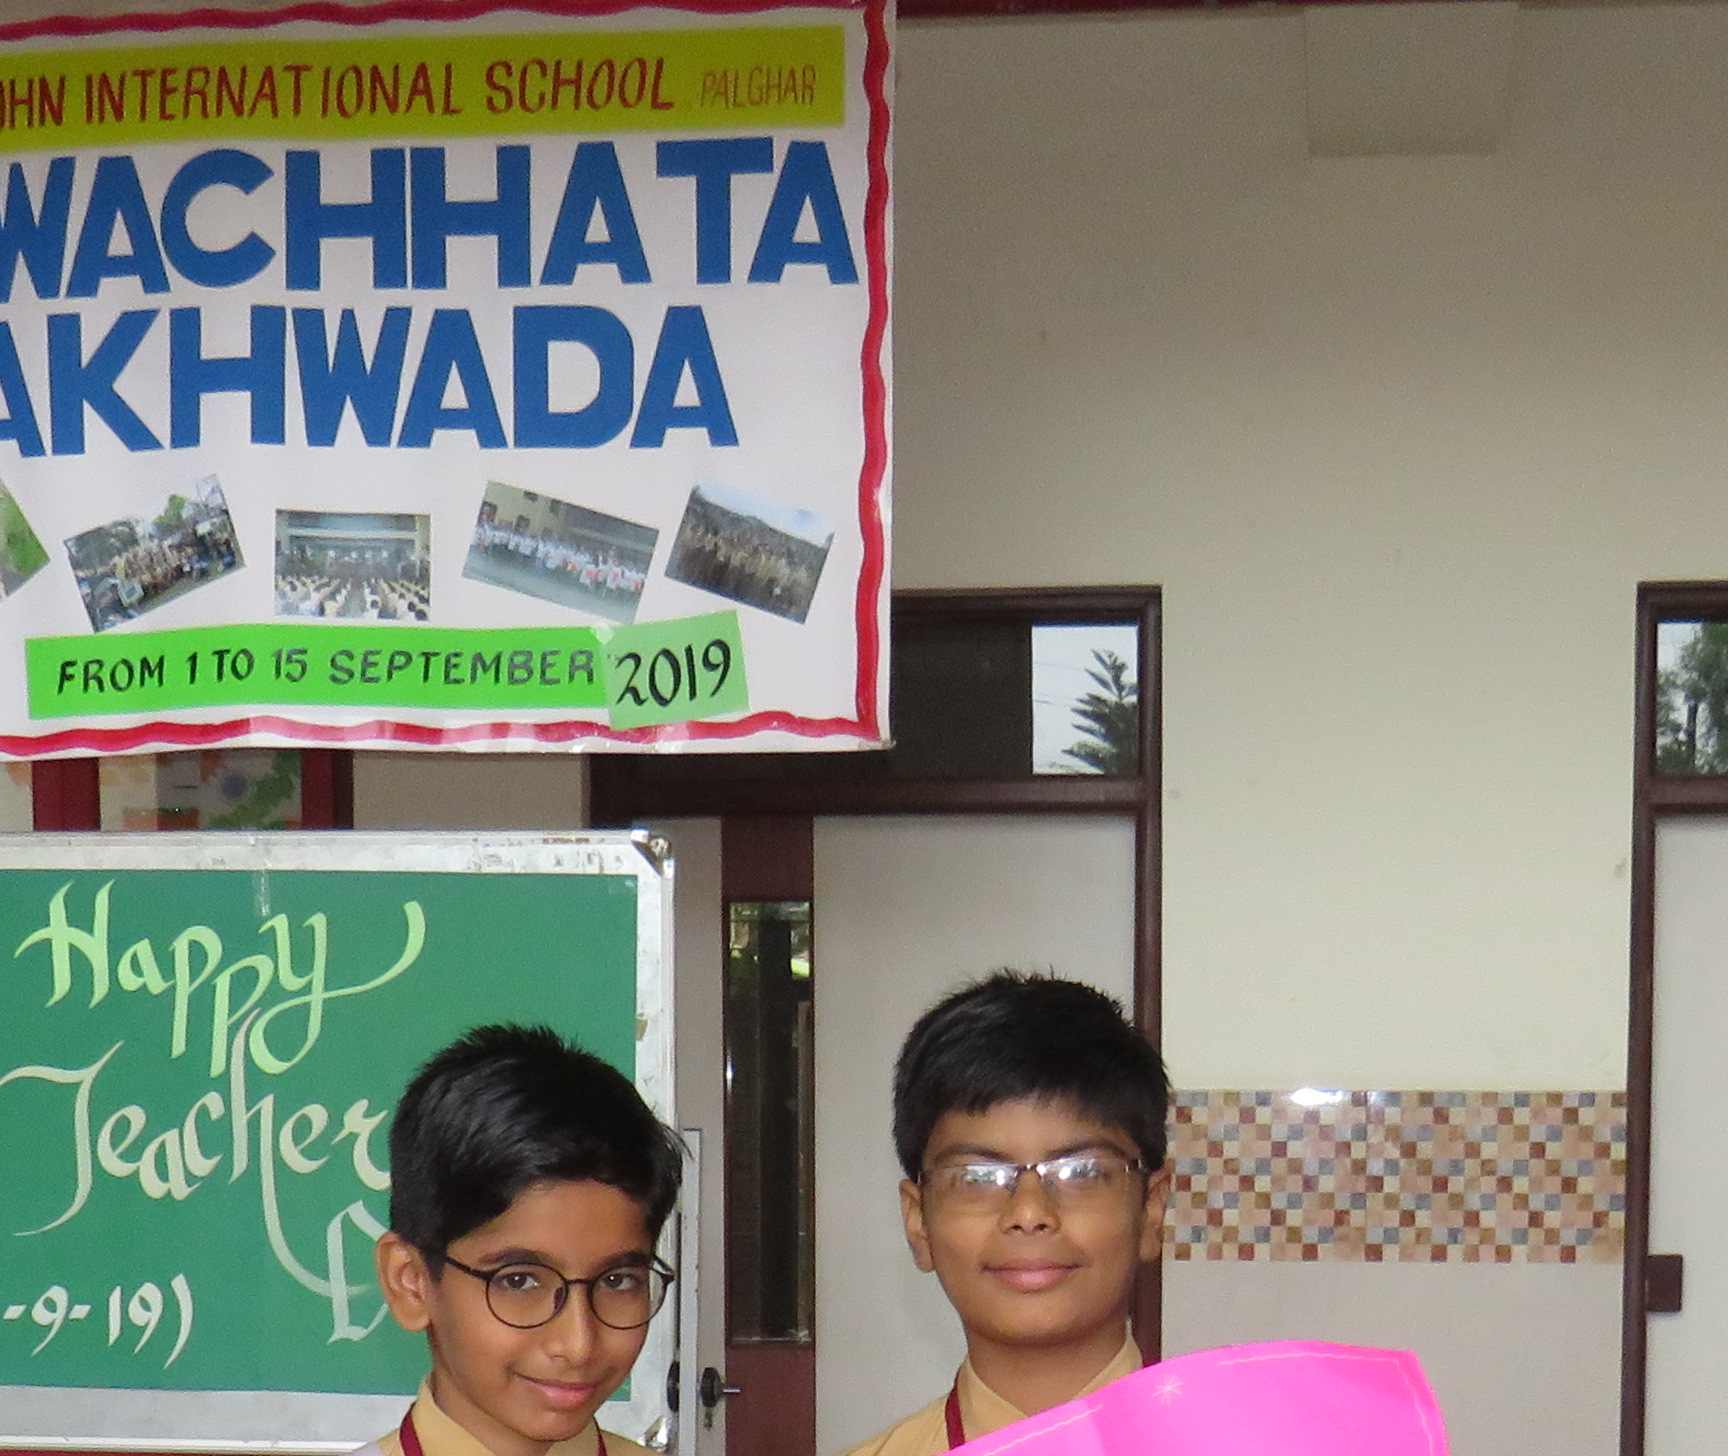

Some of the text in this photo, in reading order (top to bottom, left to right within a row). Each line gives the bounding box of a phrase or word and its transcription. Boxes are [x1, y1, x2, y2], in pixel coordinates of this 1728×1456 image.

[85, 61, 463, 124] INTERNATIONAL
[485, 56, 675, 115] SCHOOL
[700, 62, 817, 110] PALGHAR
[58, 638, 732, 710] FROM 1 TO 15 SEPTEMBER 2019
[13, 879, 427, 1077] Happy
